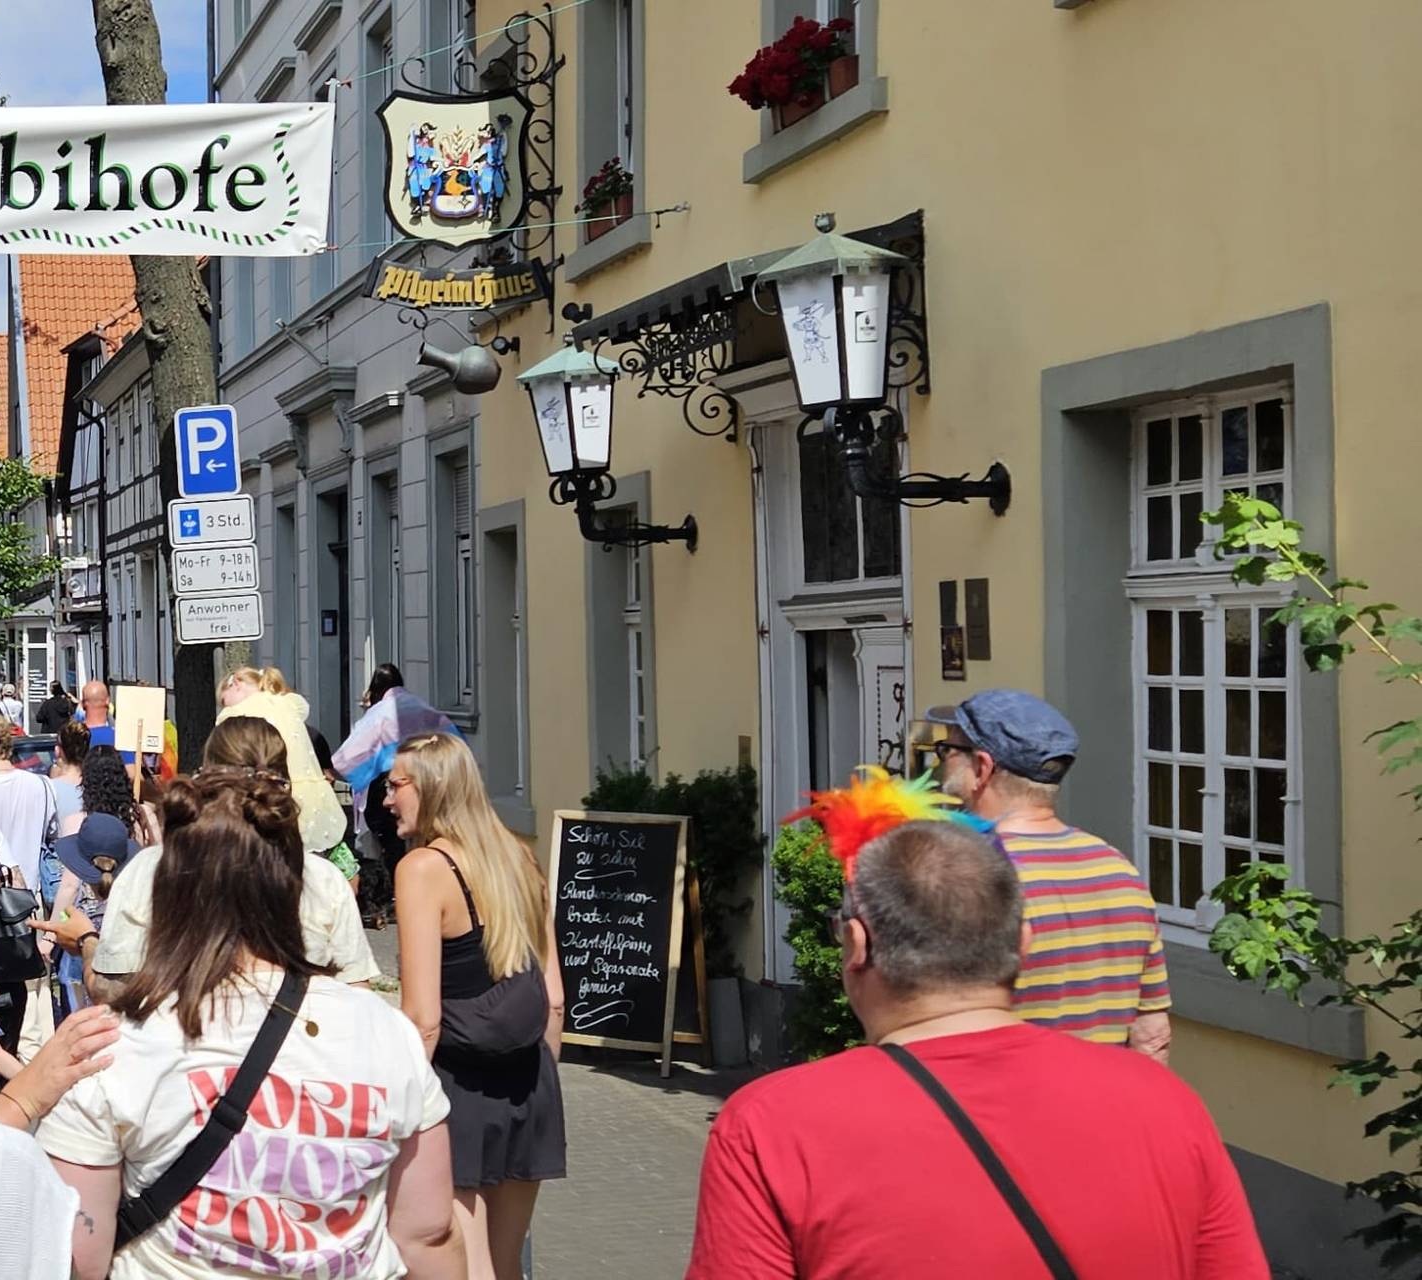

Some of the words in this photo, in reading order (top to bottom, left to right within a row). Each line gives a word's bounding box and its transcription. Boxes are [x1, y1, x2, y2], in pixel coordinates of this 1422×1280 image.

[186, 417, 227, 475] P
[206, 515, 215, 528] 3
[218, 513, 246, 527] Std.
[179, 556, 211, 569] Mo-Fr
[180, 574, 193, 587] Sa
[188, 601, 250, 615] Anwohner
[210, 621, 231, 634] frei
